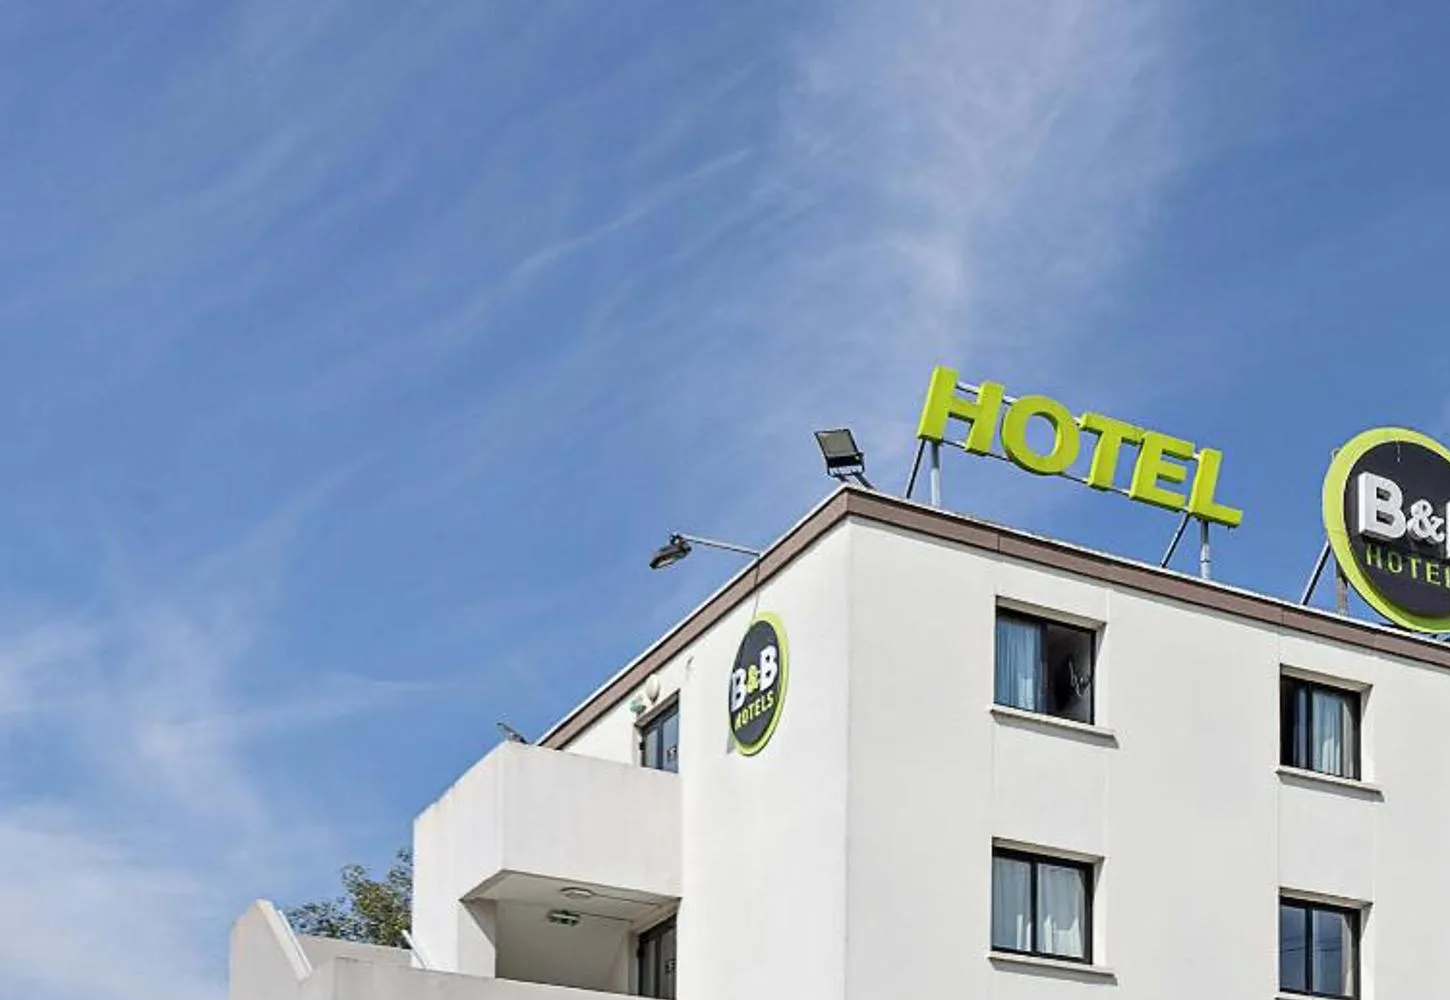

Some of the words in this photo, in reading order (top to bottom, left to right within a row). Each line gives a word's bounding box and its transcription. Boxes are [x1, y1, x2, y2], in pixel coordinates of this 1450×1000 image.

[917, 365, 1243, 528] HOTEL
[731, 645, 778, 712] B&B
[735, 690, 775, 729] HOTELS
